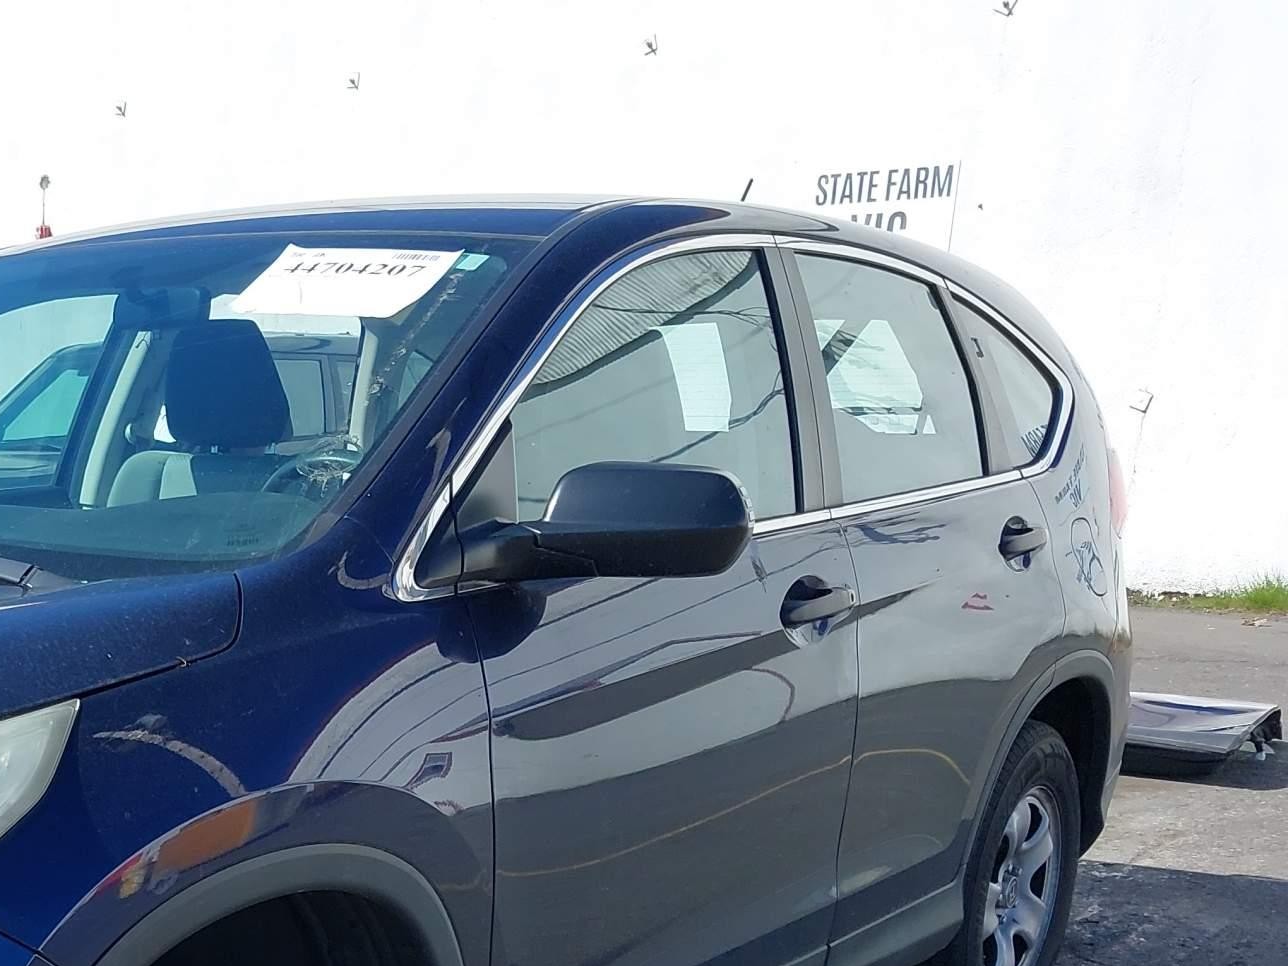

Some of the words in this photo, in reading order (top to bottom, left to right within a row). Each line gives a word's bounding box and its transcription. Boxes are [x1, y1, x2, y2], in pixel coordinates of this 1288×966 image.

[815, 170, 880, 206] STATE
[885, 164, 954, 202] FARM
[284, 262, 427, 277] 44704207
